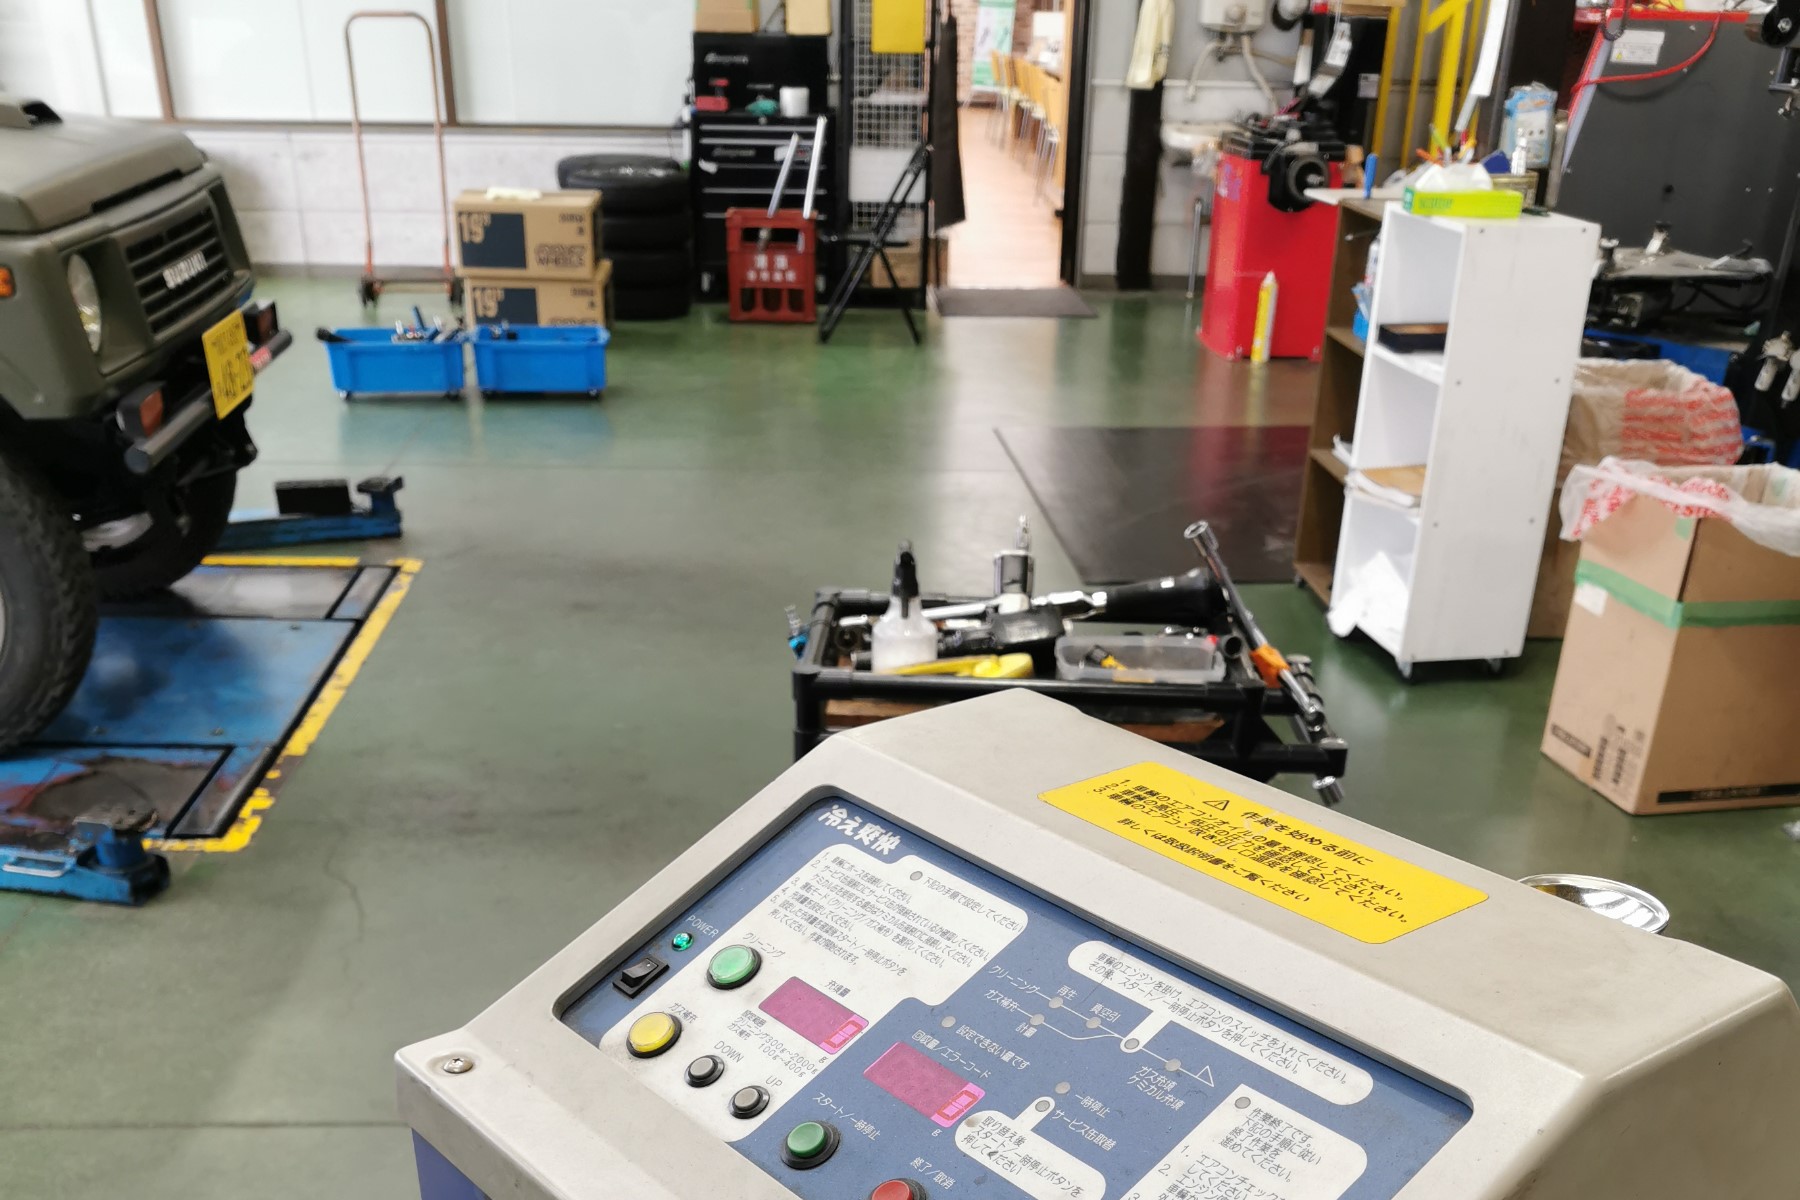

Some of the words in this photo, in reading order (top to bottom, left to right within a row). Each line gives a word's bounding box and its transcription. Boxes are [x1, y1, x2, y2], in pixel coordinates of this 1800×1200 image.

[814, 803, 907, 856] 冷え爽快
[1238, 810, 1375, 866] 作業を始める前に
[919, 876, 1027, 933] 下記の手順で設定してください
[683, 914, 720, 938] POWER
[741, 931, 786, 960] クリーニング
[986, 964, 1040, 996] クリーニング
[667, 1001, 699, 1023] ガス補充
[982, 987, 1022, 1013] ガス補充
[1054, 984, 1079, 1001] 再生
[1088, 1002, 1121, 1023] 真空引
[1013, 1021, 1038, 1038] 計量
[712, 1040, 745, 1063] DOWN
[953, 1024, 1031, 1072] 設定できない量です
[763, 1074, 783, 1089] UP
[1124, 1074, 1186, 1111] ケミカル充填
[1133, 1064, 1178, 1092] ガス充填
[1070, 1091, 1112, 1119] 一時停止
[979, 1115, 1028, 1148] 取り替え後
[1049, 1108, 1117, 1152] サービス缶取替
[1227, 1125, 1283, 1160] 終了作業を
[1238, 1116, 1324, 1166] 下記の手順に従い
[1247, 1106, 1318, 1148] 作業終了です。
[959, 1133, 1024, 1177] 押してください
[1217, 1134, 1297, 1183] 進めてください。
